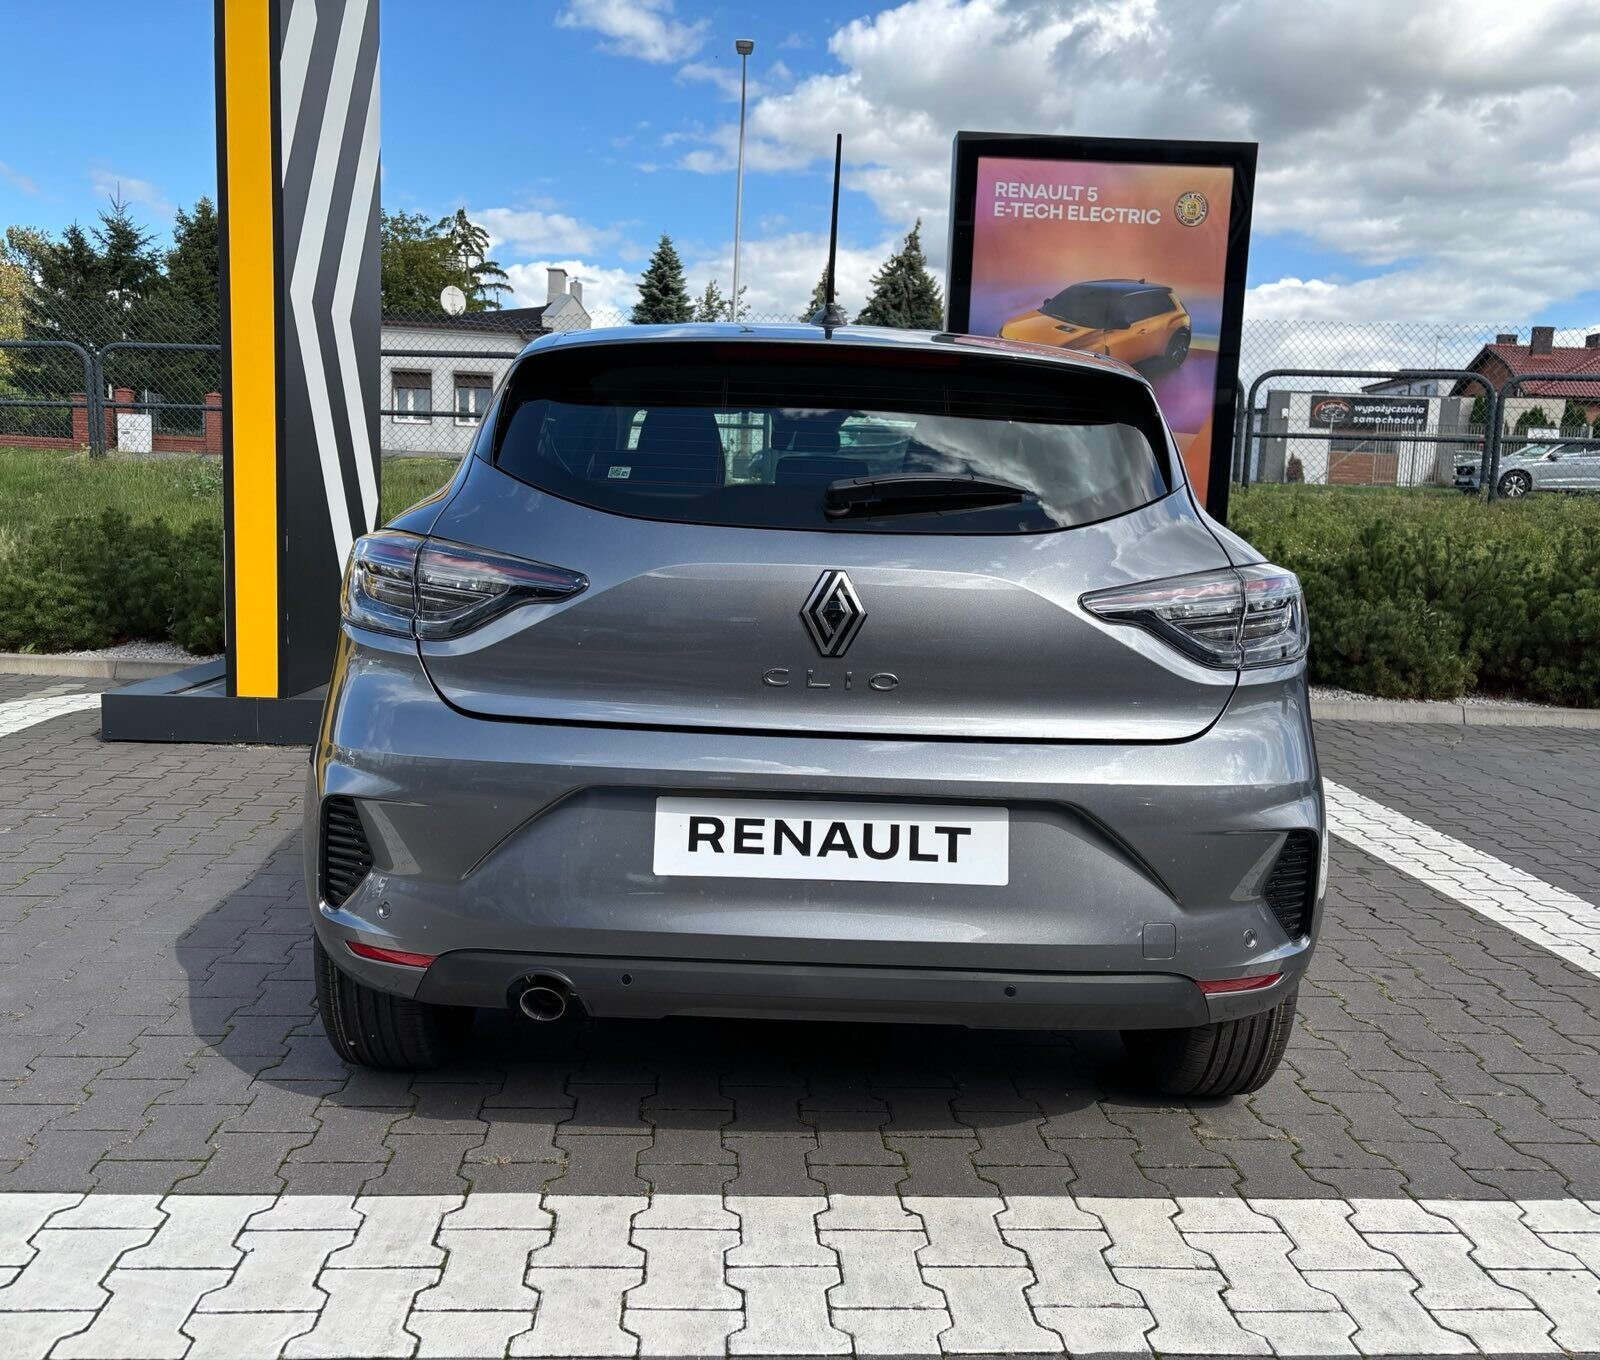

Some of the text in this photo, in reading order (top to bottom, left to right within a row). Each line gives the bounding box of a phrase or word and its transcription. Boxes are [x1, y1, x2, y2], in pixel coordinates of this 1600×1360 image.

[995, 181, 1098, 202] RENAULT 5
[993, 201, 1162, 225] E-TECH ELECTRIC
[1354, 404, 1425, 415] wypożyczalnia
[763, 668, 899, 691] CLIO
[687, 815, 972, 863] RENAULT
